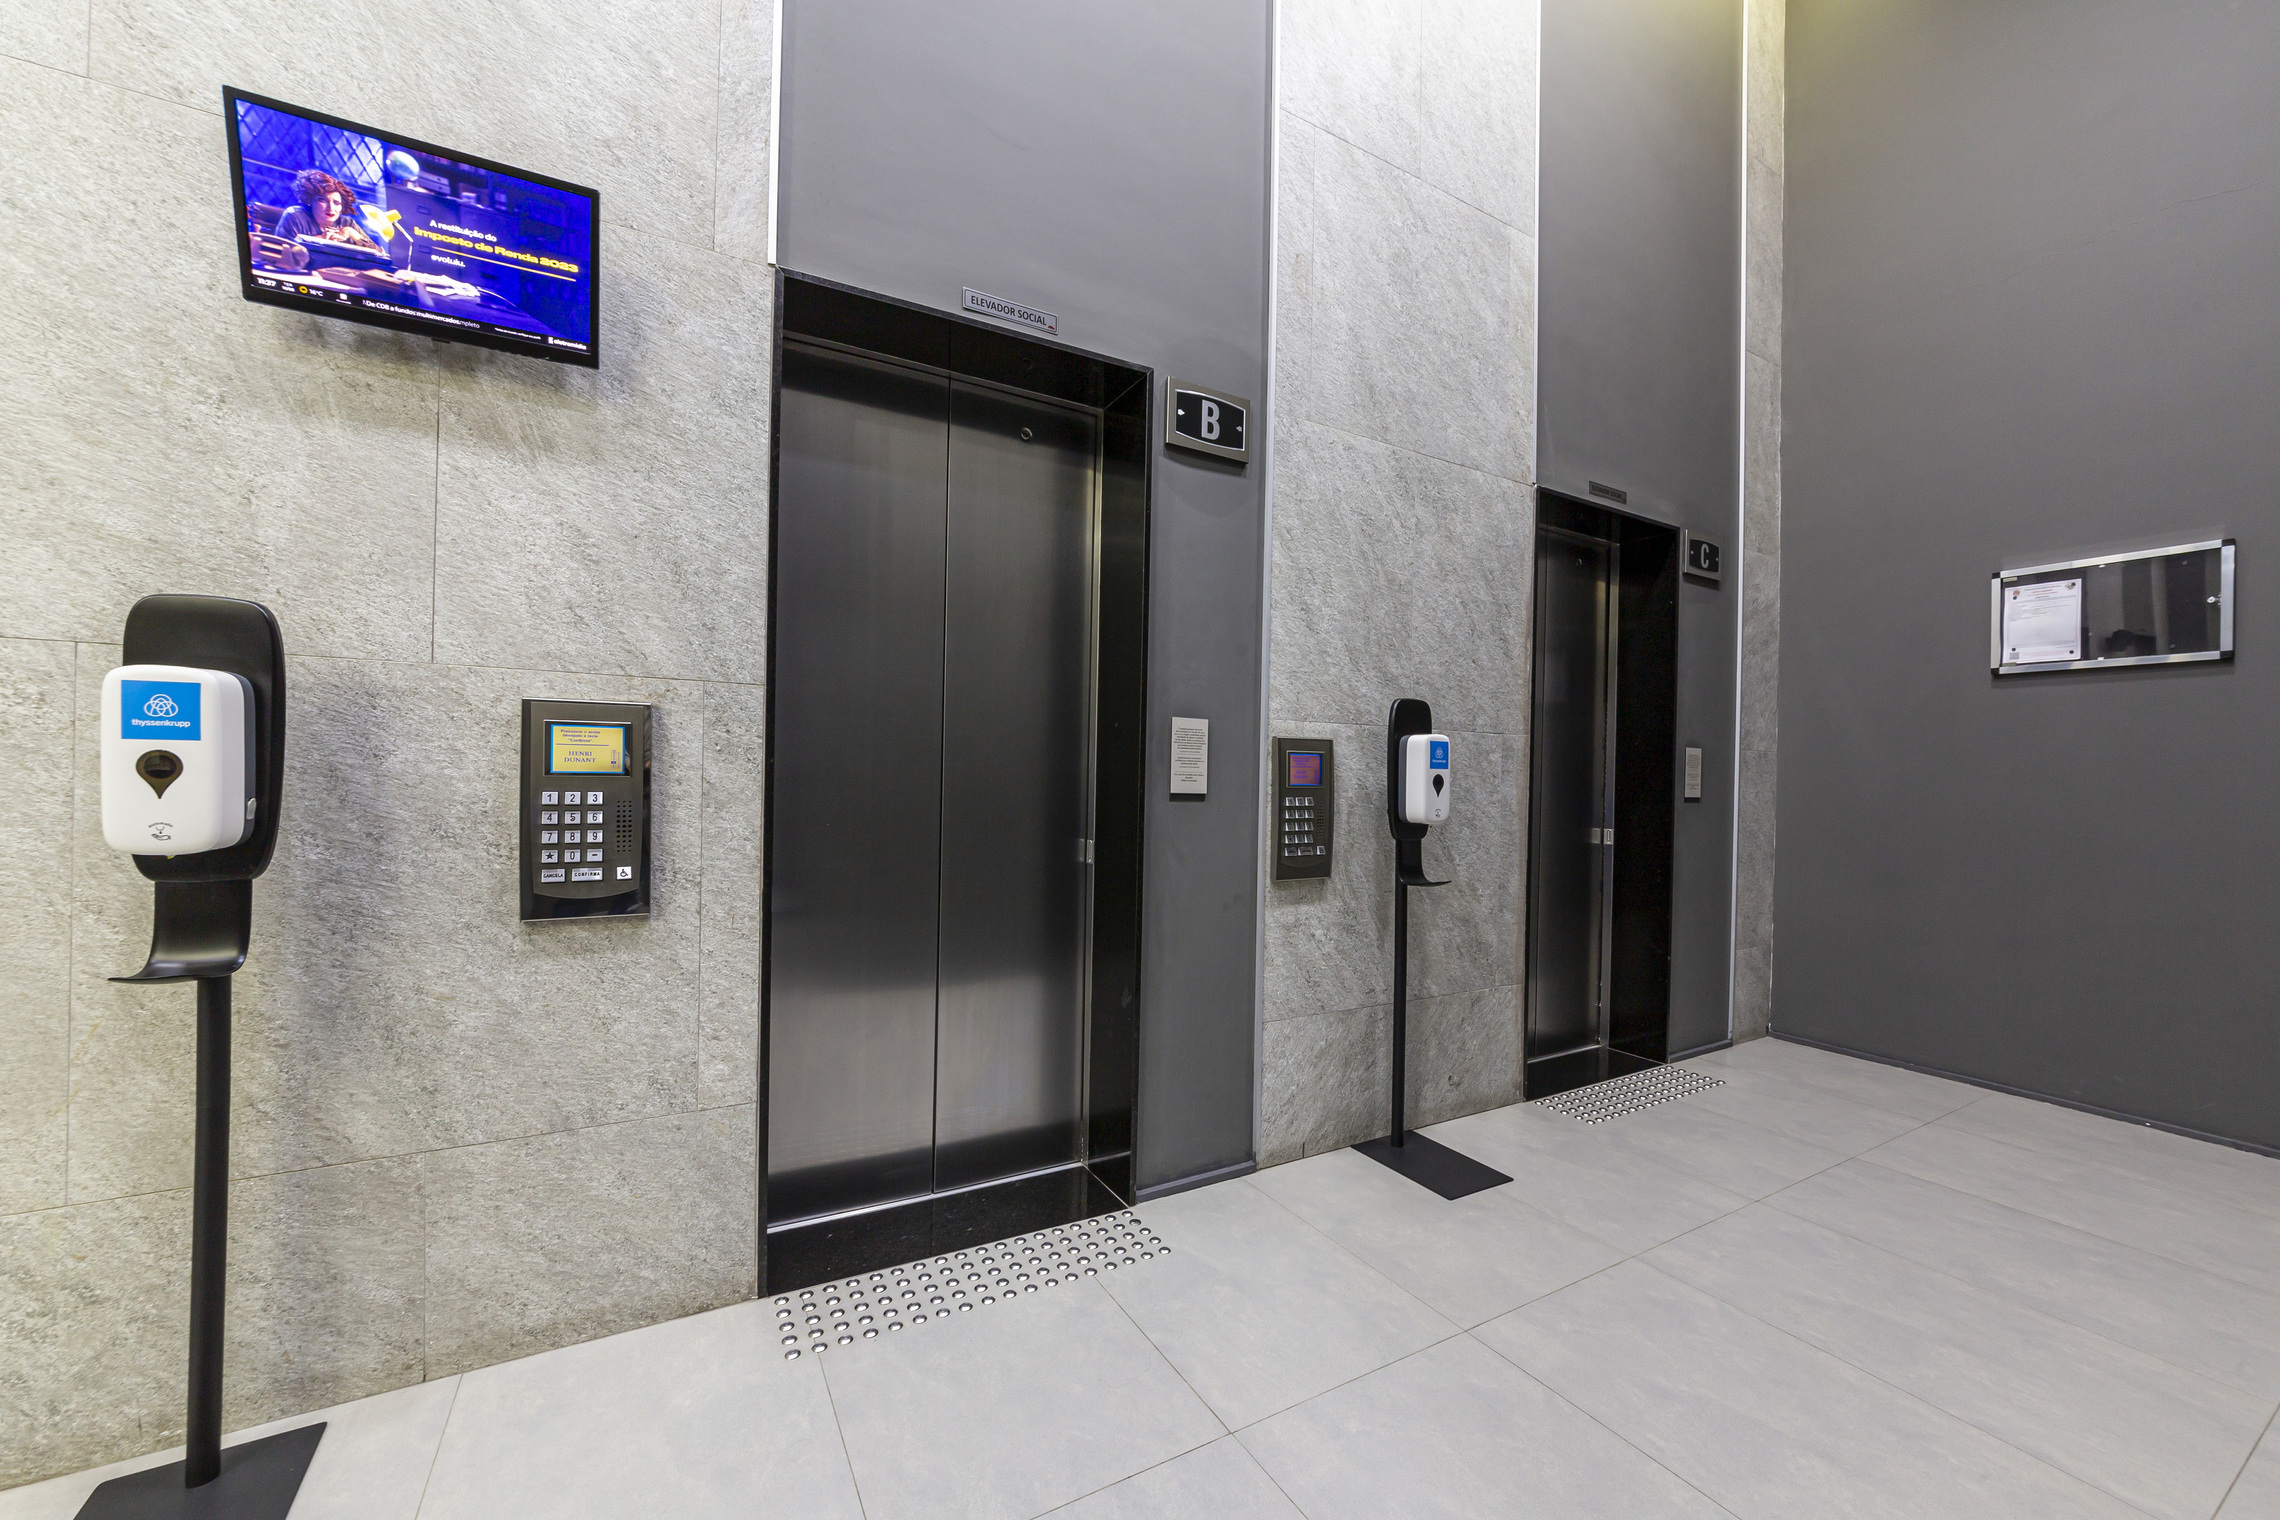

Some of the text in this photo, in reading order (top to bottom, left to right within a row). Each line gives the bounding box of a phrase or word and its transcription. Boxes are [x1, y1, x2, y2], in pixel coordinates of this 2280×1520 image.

[430, 219, 497, 242] A restituição do
[414, 226, 579, 273] Imposto de Renda 2023
[970, 295, 1047, 326] ELEVADOR SOCIAL
[1201, 399, 1220, 440] B
[1700, 543, 1709, 569] C
[131, 718, 191, 728] thyssenkrupp
[547, 793, 598, 803] 1 2 3
[546, 812, 598, 822] 4 5 6
[547, 831, 598, 842] 7 8 9
[569, 851, 575, 861] 0
